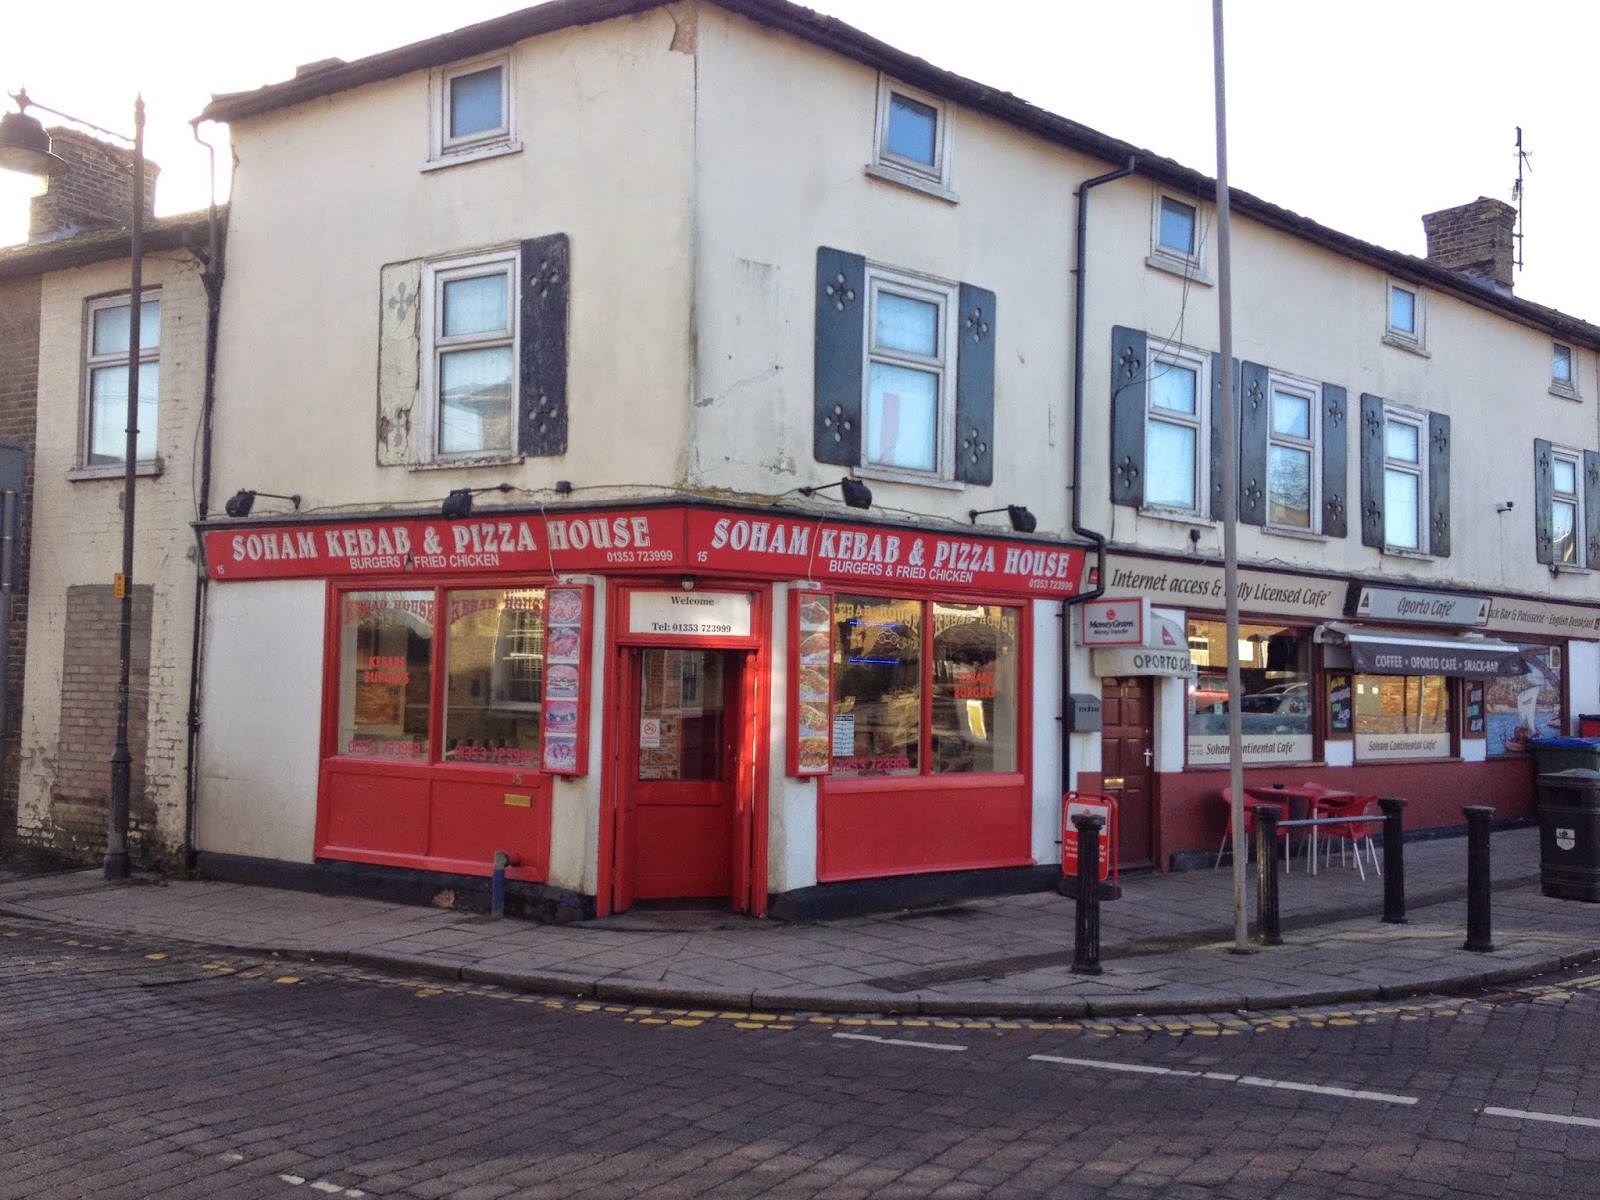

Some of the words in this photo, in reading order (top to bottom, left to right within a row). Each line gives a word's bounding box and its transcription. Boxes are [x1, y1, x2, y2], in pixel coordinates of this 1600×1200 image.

[232, 531, 318, 561] SOHAM
[325, 526, 411, 557] KEBAB
[423, 526, 442, 554] &
[452, 522, 537, 552] PIZZA
[547, 516, 650, 549] HOUSE
[711, 518, 810, 556] SOHAM
[819, 529, 900, 563] KEBAB
[908, 538, 925, 566] &
[934, 541, 995, 572] PIZZA
[1004, 548, 1070, 578] HOUSE
[350, 556, 400, 569] BURGERS
[414, 555, 447, 568] FRIED
[450, 554, 499, 567] CHICKEN
[606, 551, 634, 563] 01353
[637, 550, 673, 562] 723999
[697, 551, 708, 562] 15
[216, 565, 224, 574] 15
[829, 559, 883, 575] BURGERS
[885, 565, 893, 577] &
[896, 566, 926, 580] FRIED
[929, 569, 973, 583] CHICKEN
[1029, 579, 1048, 588] 01353
[1049, 580, 1073, 590] 723999
[1111, 569, 1167, 591] Internet
[1169, 578, 1209, 595] access
[1211, 579, 1222, 597] &
[1254, 583, 1302, 604] Licensed
[671, 596, 715, 606] Welcome
[1398, 597, 1430, 615] Oporto
[834, 603, 871, 619] EBAB
[652, 622, 670, 632] Tel:
[672, 623, 699, 633] 01353
[701, 624, 731, 634] 723999
[1090, 619, 1134, 629] MoneyGram
[1133, 654, 1177, 670] OPORTO
[1375, 655, 1403, 668] COFFEE
[1410, 656, 1438, 669] OPORTO
[1241, 742, 1275, 754] ntinental
